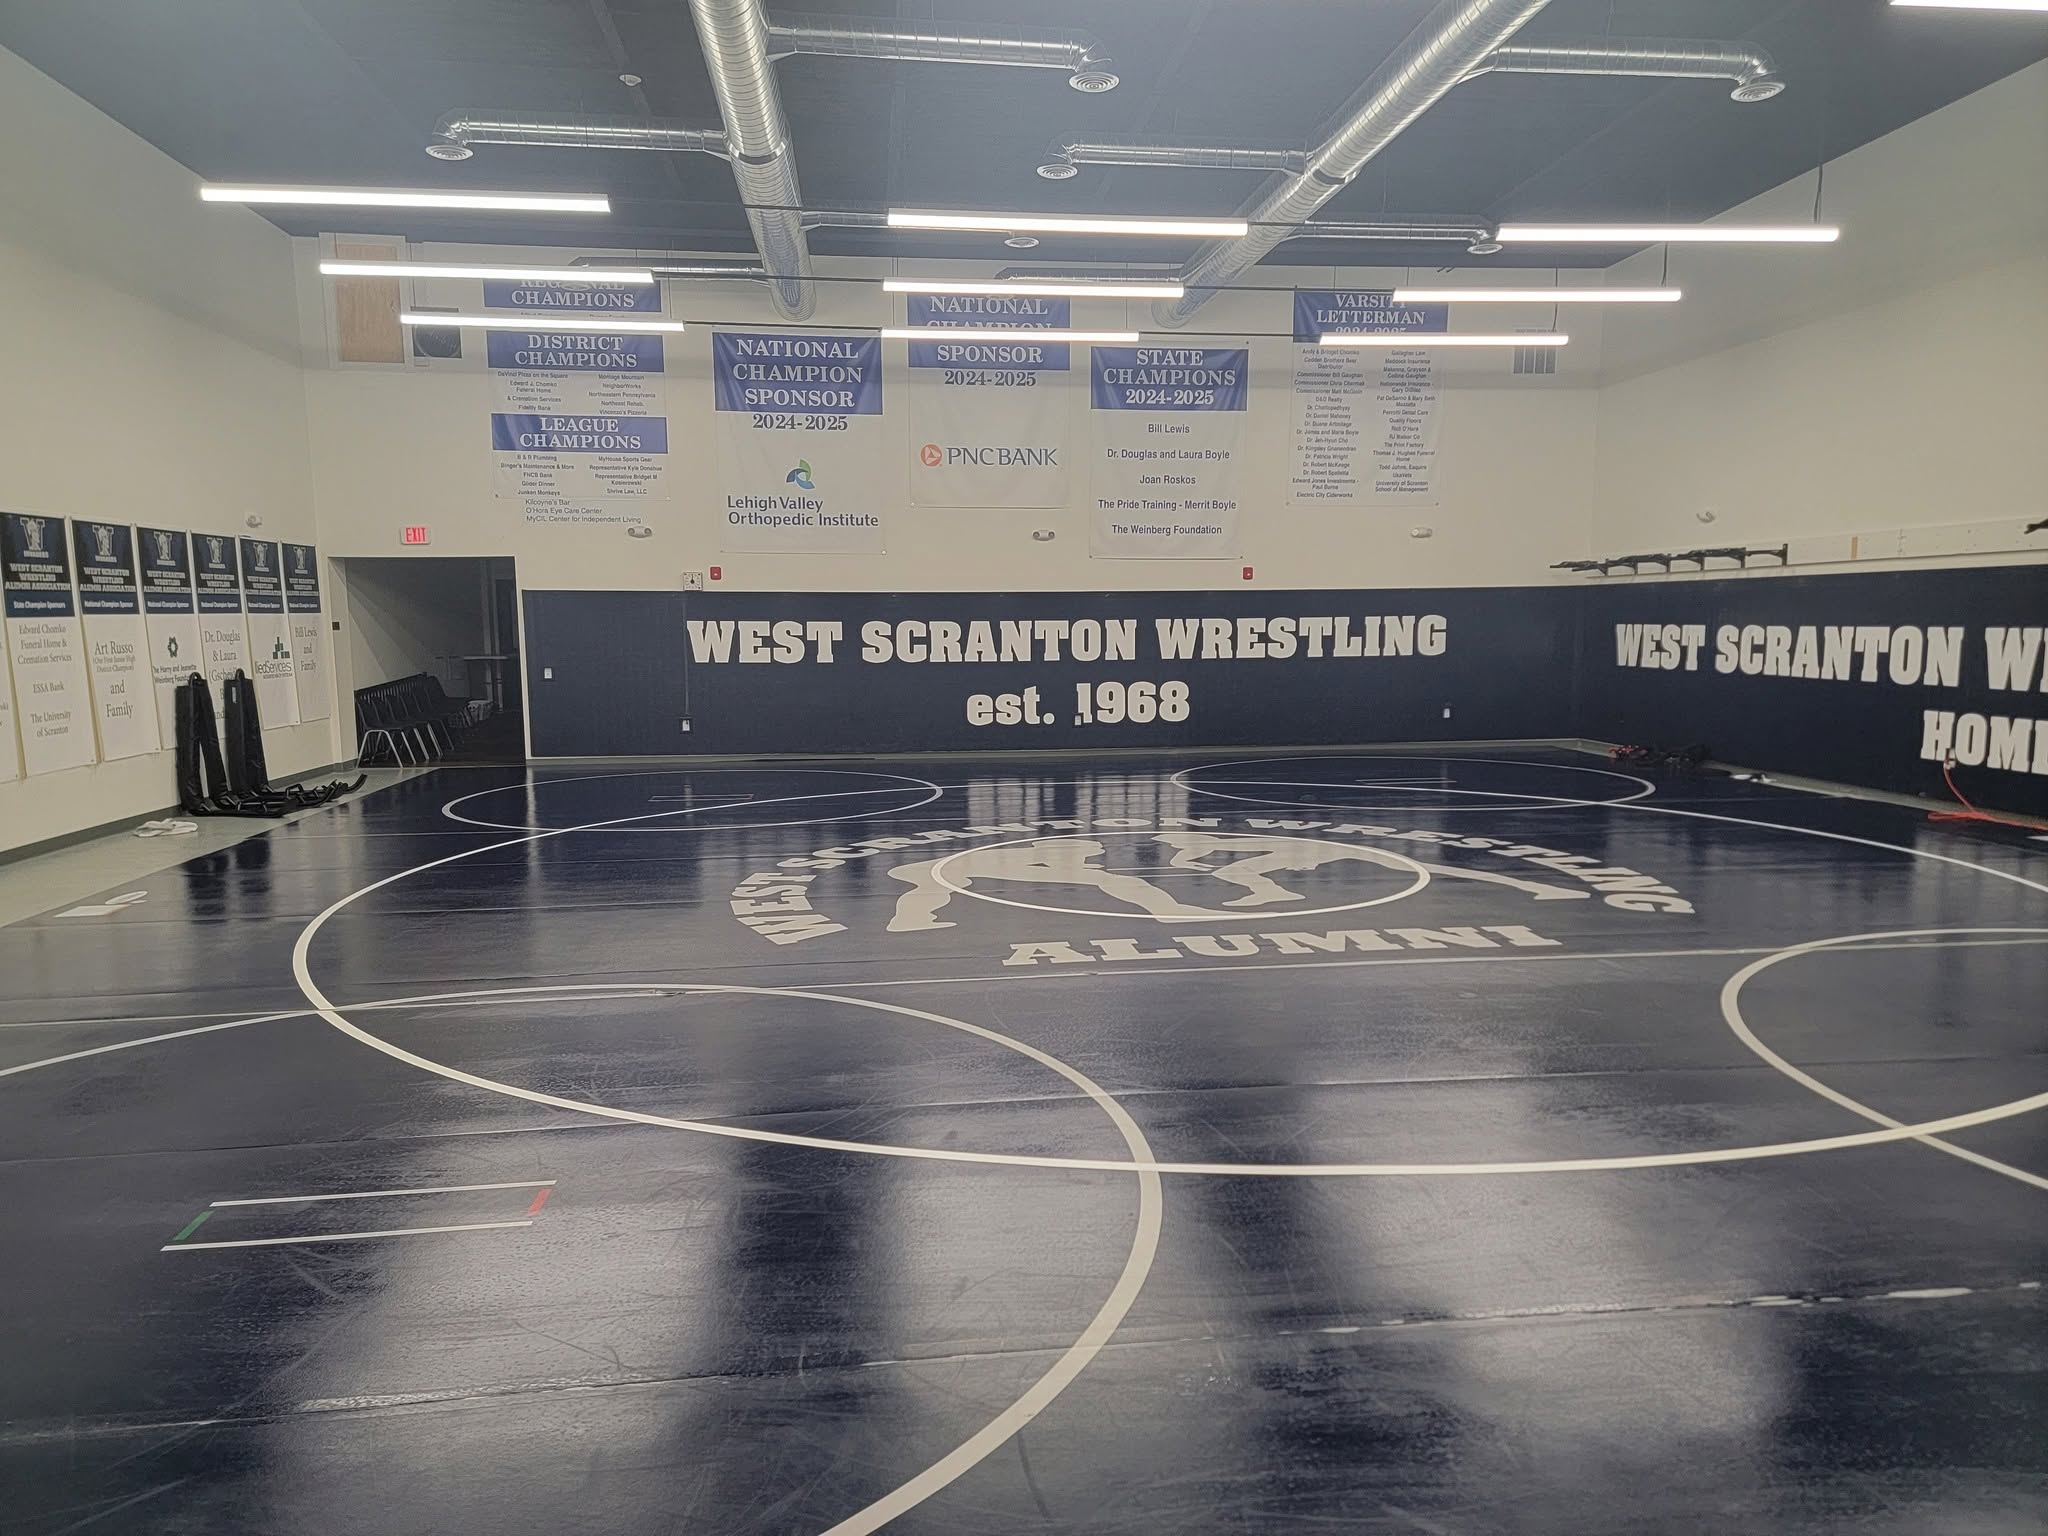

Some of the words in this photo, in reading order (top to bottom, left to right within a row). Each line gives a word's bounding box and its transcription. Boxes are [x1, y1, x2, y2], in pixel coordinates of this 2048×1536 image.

[512, 290, 635, 307] CHAMPIONS
[930, 296, 1048, 315] NATIONAL
[1317, 310, 1425, 324] LETTERMAN
[528, 335, 623, 350] DISTRICT
[736, 339, 859, 359] NATIONAL
[515, 351, 637, 367] CHAMPIONS
[937, 344, 1044, 363] SPONSOR
[1136, 349, 1204, 366] STATE
[733, 364, 863, 383] CHAMPION
[944, 370, 1037, 387] 2024-2025
[1103, 368, 1236, 386] CHAMPIONS
[745, 388, 855, 408] SPONSOR
[1126, 389, 1214, 406] 2024-2025
[540, 418, 619, 432] LEAGUE
[753, 414, 848, 431] 2024-2025
[1148, 423, 1163, 434] Bill
[1166, 424, 1190, 434] Lewis
[519, 434, 641, 449] CHAMPIONS
[1107, 449, 1119, 460] Dr.
[1121, 450, 1157, 461] Douglas
[1159, 450, 1176, 460] and
[1178, 450, 1203, 460] Laura
[1205, 450, 1230, 461] Boyle
[1139, 475, 1161, 485] Joan
[1163, 475, 1196, 485] Roskos
[727, 494, 777, 511] Lehigh
[779, 497, 824, 513] Valley
[1098, 500, 1115, 510] The
[1117, 500, 1139, 510] Pride
[1141, 500, 1177, 512] Training
[1184, 500, 1210, 510] Merrit
[1212, 500, 1237, 512] Boyle
[728, 512, 813, 527] Orthopedic
[819, 514, 879, 526] Institute
[406, 527, 426, 542] EXIT
[1112, 524, 1128, 535] The
[1130, 524, 1171, 536] Weinberg
[1173, 524, 1222, 535] Foundation
[19, 624, 40, 634] Edward
[304, 627, 318, 637] Lewis
[21, 639, 42, 649] Funeral
[43, 639, 61, 648] Home
[62, 639, 67, 647] &
[205, 631, 214, 643] Dr.
[216, 629, 240, 645] Douglas
[686, 619, 843, 664] WEST
[861, 618, 1138, 664] SCRANTON
[1155, 614, 1448, 661] WRESTLING
[95, 642, 108, 655] Art
[110, 641, 133, 653] Russo
[213, 651, 219, 661] &
[220, 650, 237, 661] Laura
[304, 643, 312, 654] and
[1616, 623, 1706, 672] WEST
[1715, 624, 1965, 688] SCRANTON
[18, 655, 49, 665] Cremation
[50, 654, 72, 662] Services
[301, 660, 316, 673] Family
[33, 683, 49, 693] ESSA
[50, 681, 64, 691] Bank
[111, 680, 125, 694] and
[106, 701, 133, 719] Family
[966, 683, 1055, 727] est.
[1075, 680, 1192, 725] 1968
[30, 713, 42, 724] The
[43, 711, 71, 722] University
[37, 728, 43, 737] of
[44, 726, 68, 736] Scranton
[776, 817, 1222, 869] SCRANTON
[1245, 818, 1696, 914] WRESTLING
[730, 872, 848, 945] WEST
[1001, 925, 1563, 966] ALUMNI
